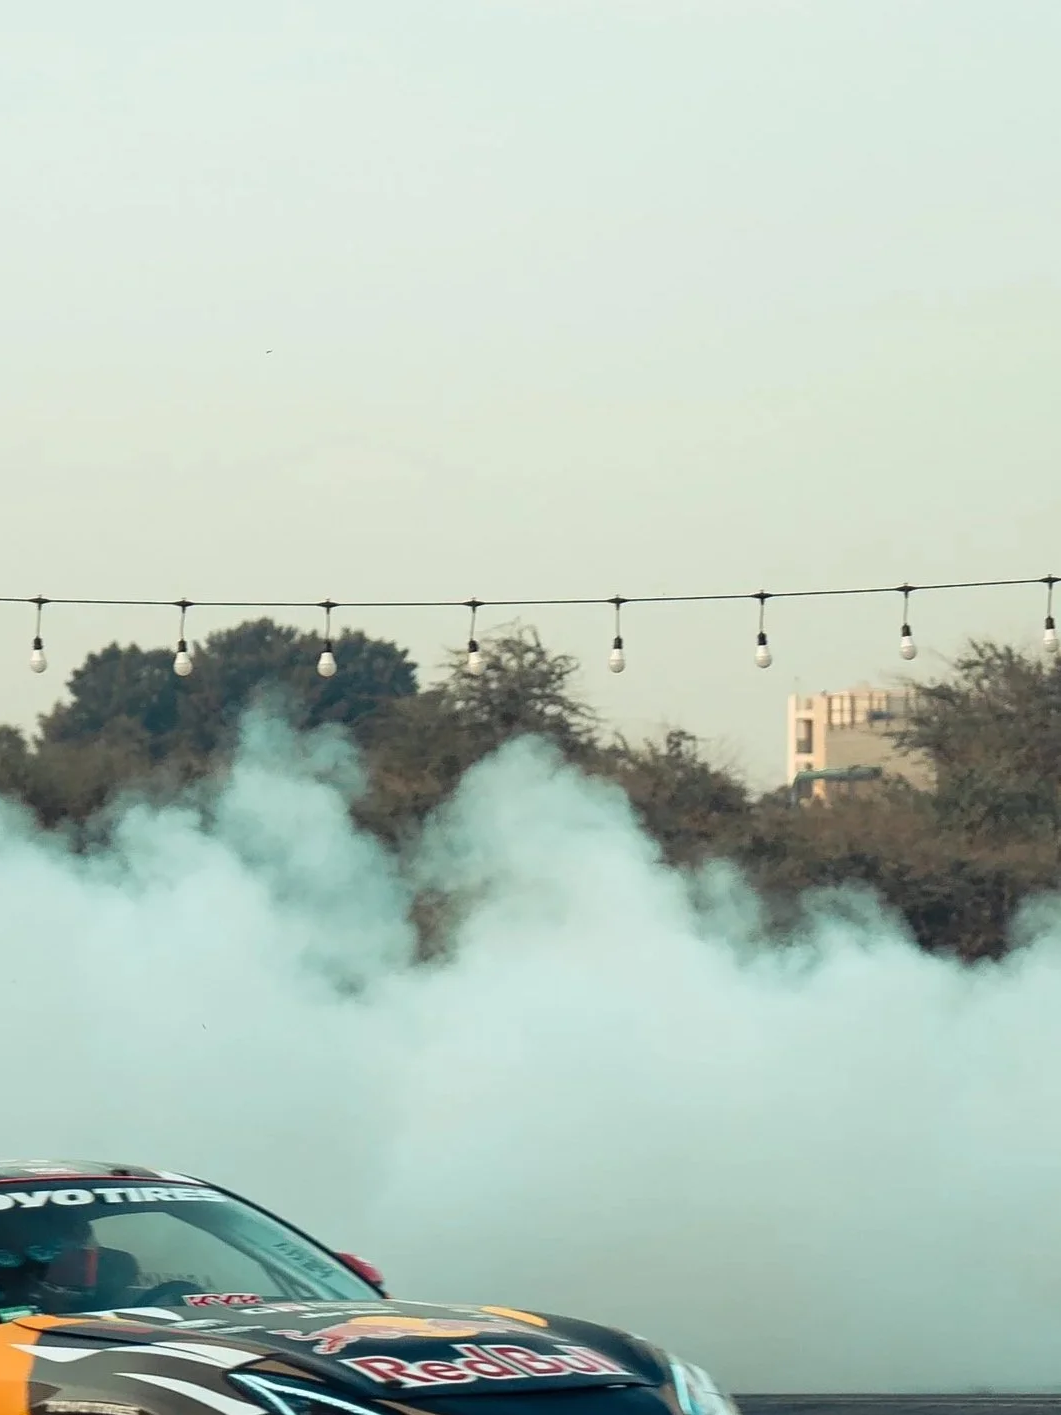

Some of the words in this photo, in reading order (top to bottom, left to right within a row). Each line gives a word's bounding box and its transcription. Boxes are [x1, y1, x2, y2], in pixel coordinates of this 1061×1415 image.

[92, 1187, 227, 1203] TIRES
[337, 1344, 531, 1389] Red
[480, 1344, 634, 1376] Bull
